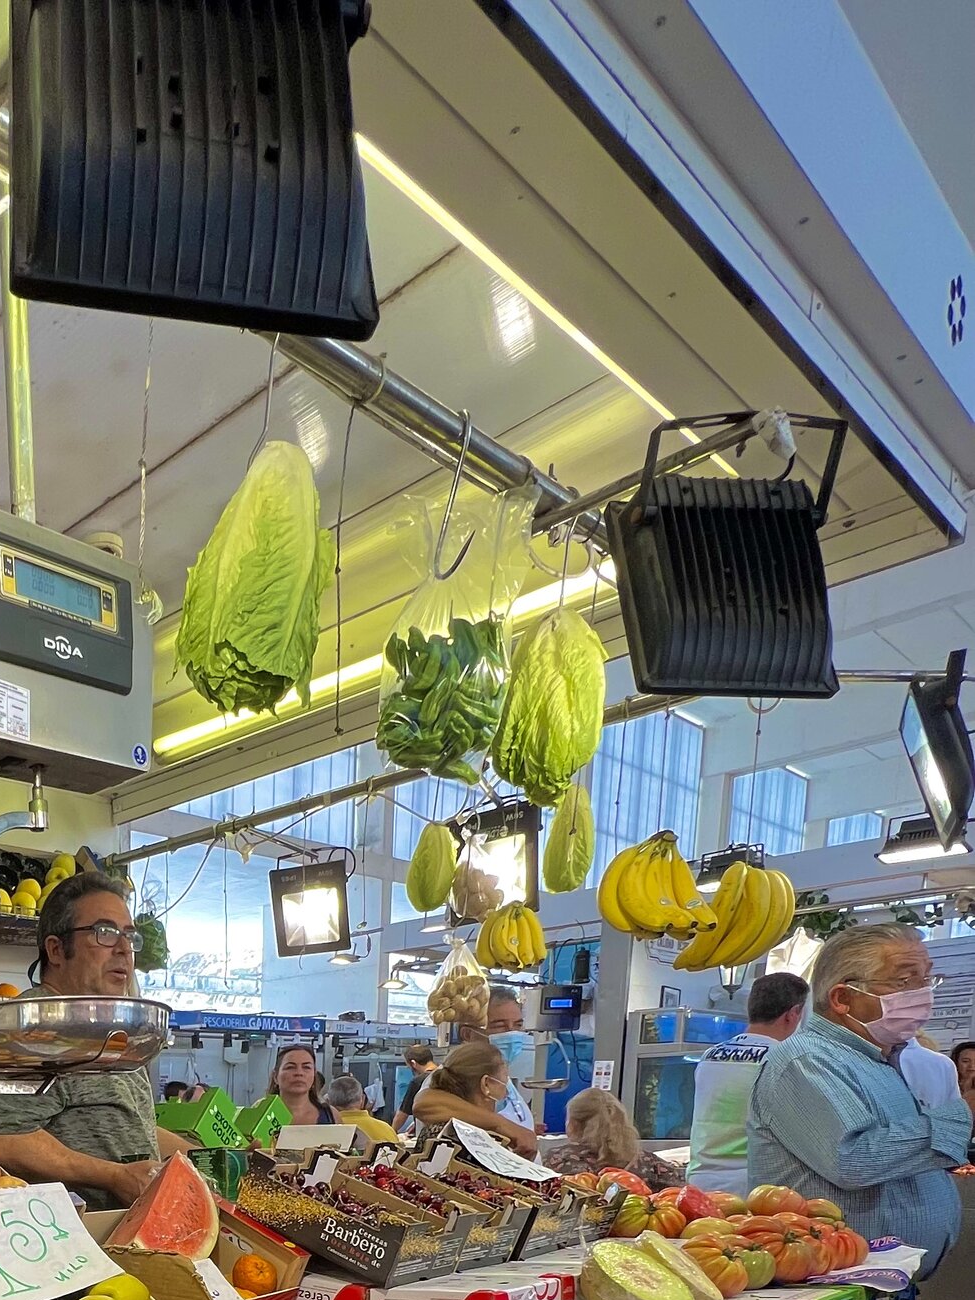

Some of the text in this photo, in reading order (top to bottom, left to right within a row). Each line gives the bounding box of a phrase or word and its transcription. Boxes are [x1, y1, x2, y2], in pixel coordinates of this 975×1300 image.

[44, 637, 83, 659] DINA
[248, 1017, 290, 1032] GAMAZA
[212, 1122, 230, 1146] GOLD
[215, 1111, 238, 1141] EXOTIC
[323, 1217, 386, 1260] Barbero
[358, 1226, 388, 1248] Cerezas
[320, 1232, 329, 1242] El
[370, 1259, 381, 1269] de
